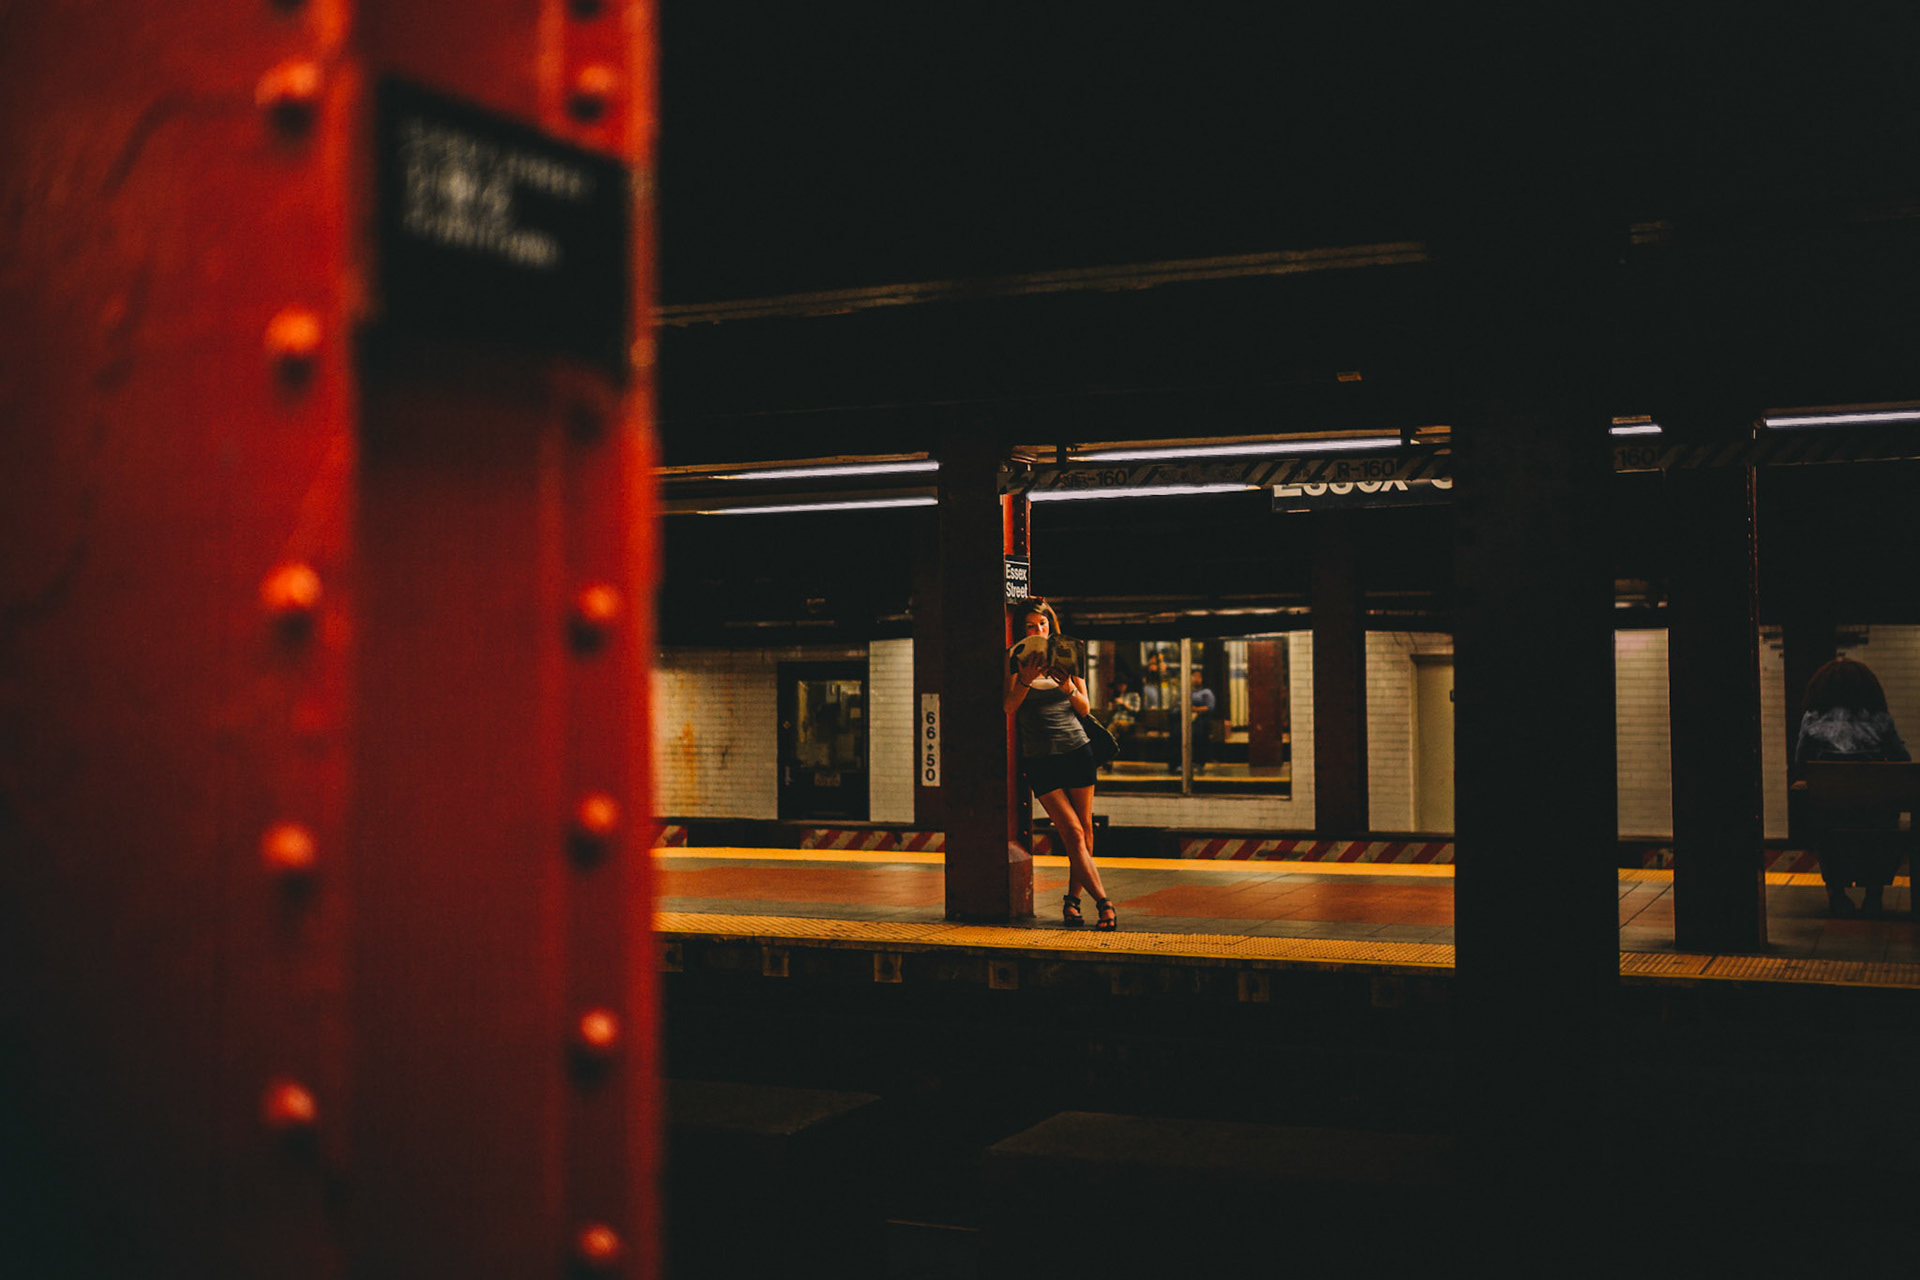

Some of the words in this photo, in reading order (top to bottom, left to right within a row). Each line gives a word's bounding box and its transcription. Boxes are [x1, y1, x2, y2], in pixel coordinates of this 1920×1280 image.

[1336, 460, 1395, 478] R-160
[1005, 564, 1028, 581] Essex
[1005, 581, 1028, 599] Street
